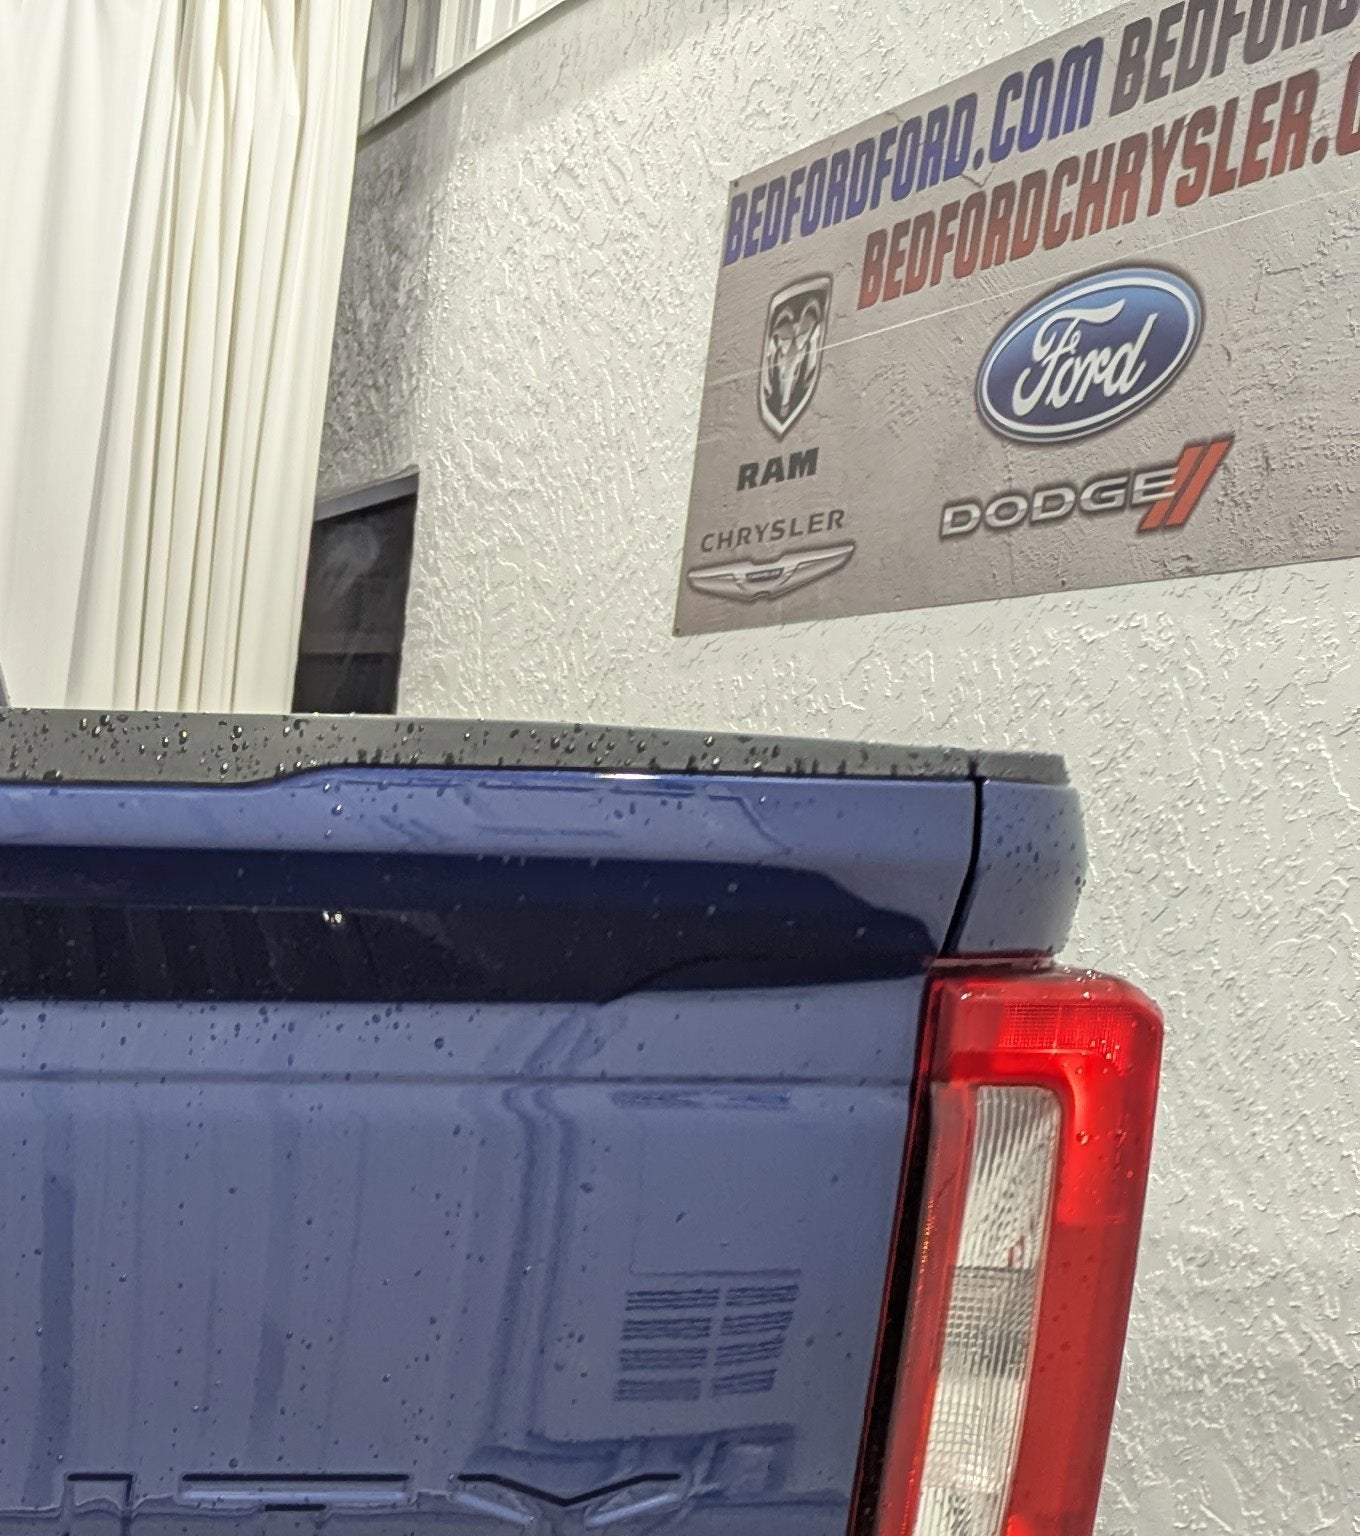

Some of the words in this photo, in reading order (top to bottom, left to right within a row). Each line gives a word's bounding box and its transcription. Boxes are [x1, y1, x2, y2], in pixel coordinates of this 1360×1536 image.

[723, 37, 1104, 267] BEDFORDFORD.COM
[1012, 298, 1158, 417] Ford
[736, 446, 820, 492] RAM
[939, 466, 1178, 537] DODGE
[700, 508, 845, 553] CHRYSLER
